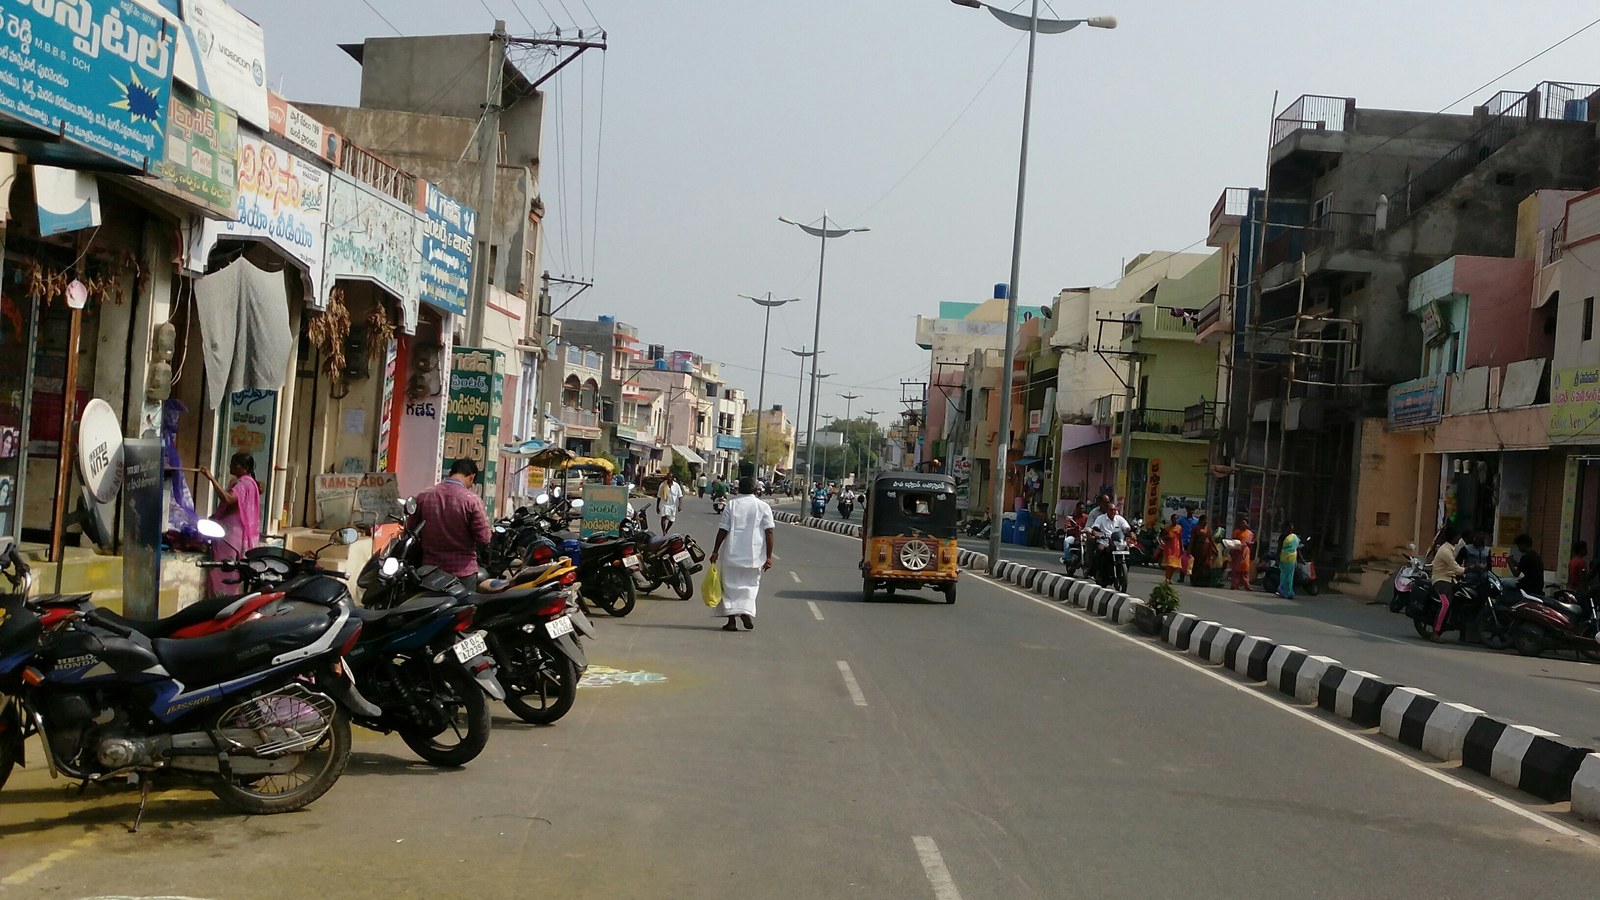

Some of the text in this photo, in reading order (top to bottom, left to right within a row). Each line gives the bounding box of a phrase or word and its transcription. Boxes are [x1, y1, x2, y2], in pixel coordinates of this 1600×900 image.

[72, 56, 91, 72] DCH
[406, 402, 436, 420] గణేష్
[460, 640, 469, 651] AP
[462, 641, 485, 660] AZ2397
[54, 658, 99, 670] HONDA
[57, 653, 94, 665] HERO
